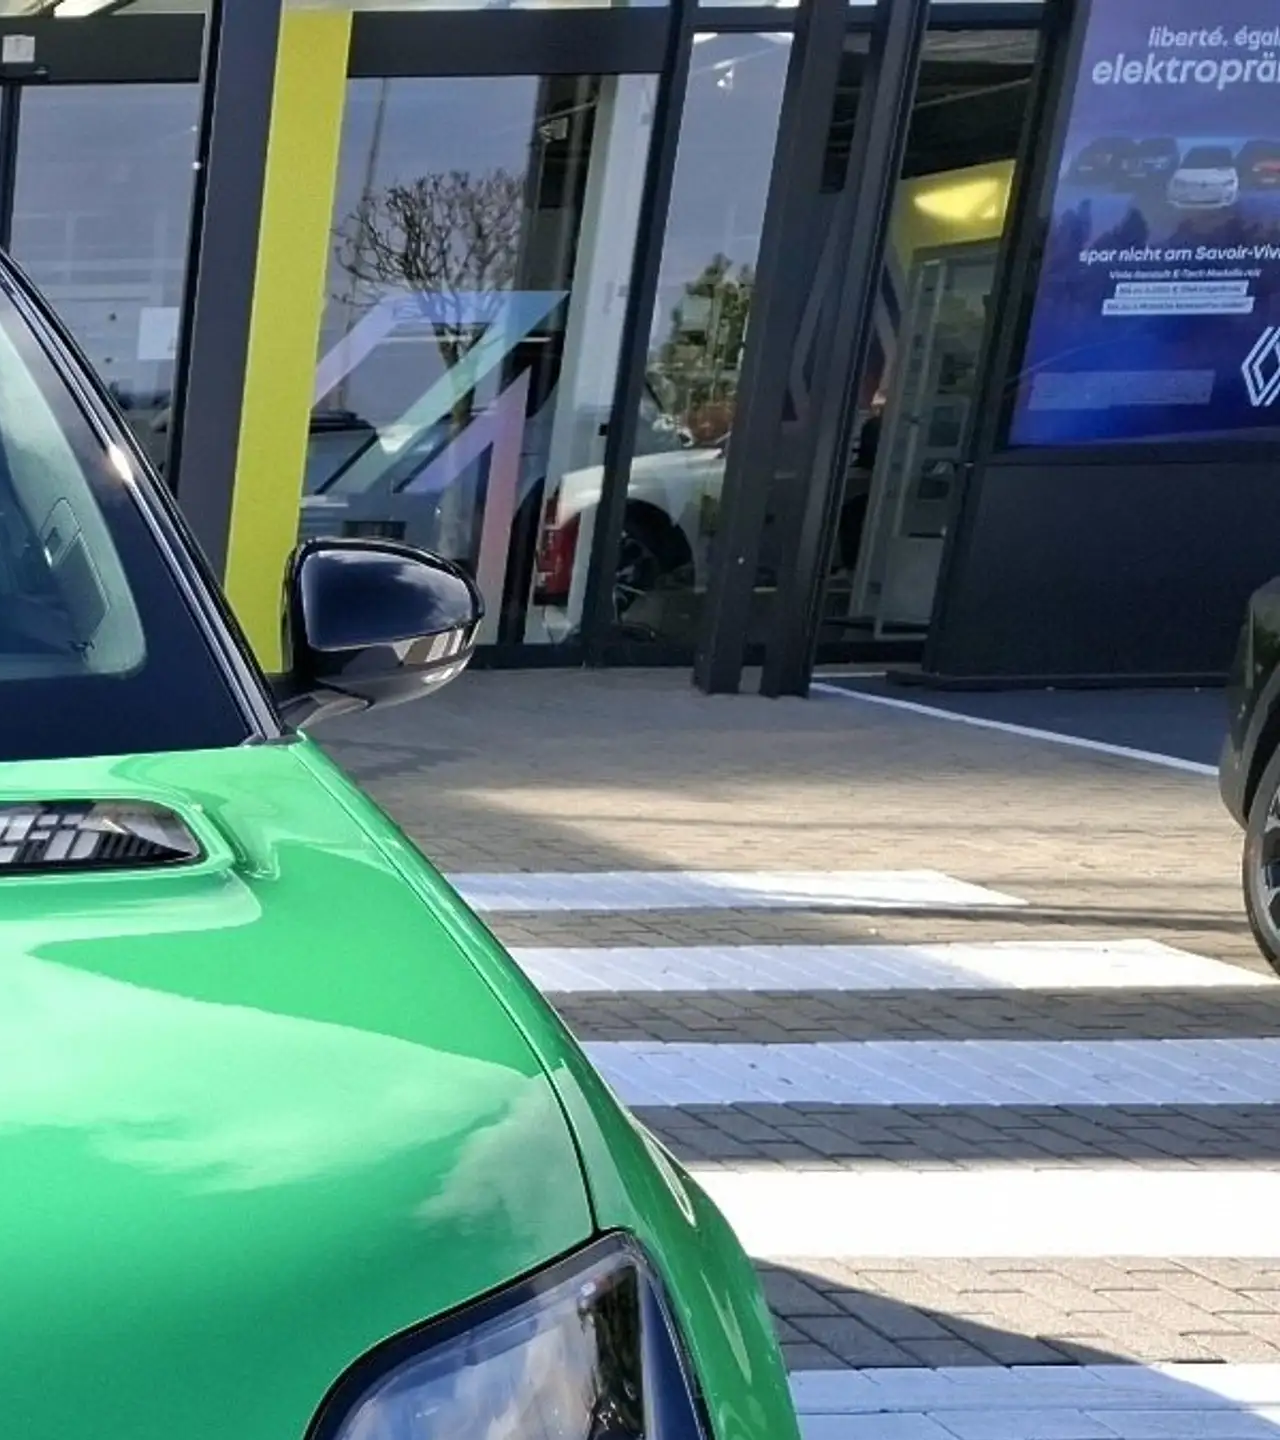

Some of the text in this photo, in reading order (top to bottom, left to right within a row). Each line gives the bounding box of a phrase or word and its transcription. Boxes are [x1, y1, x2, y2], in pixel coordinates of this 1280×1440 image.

[1233, 25, 1280, 51] égal
[1091, 51, 1280, 91] elektroprä
[1078, 242, 1280, 266] spar nicht am Savoir-Viv
